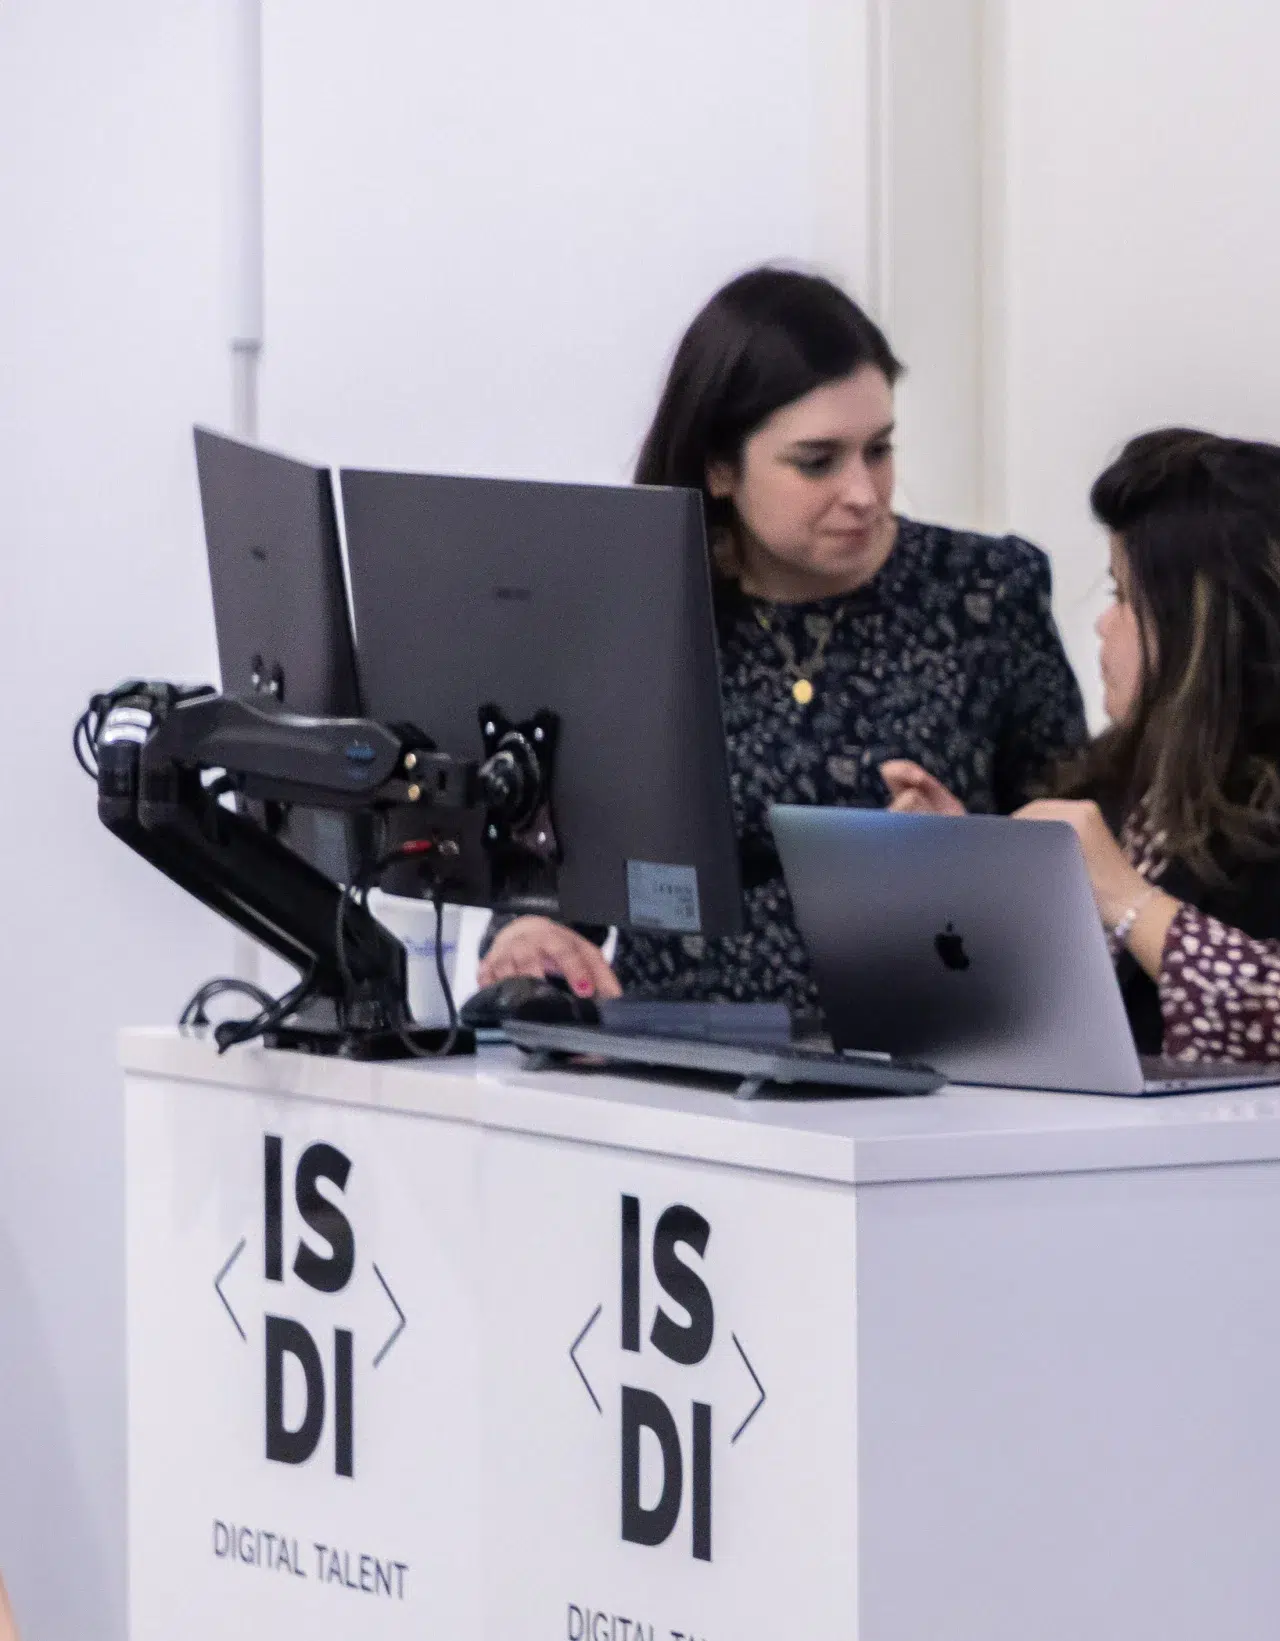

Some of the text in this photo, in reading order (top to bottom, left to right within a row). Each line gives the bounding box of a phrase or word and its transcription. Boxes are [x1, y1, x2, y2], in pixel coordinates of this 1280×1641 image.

[264, 1132, 355, 1294] IS
[620, 1193, 714, 1366] IS
[264, 1311, 355, 1478] DI
[620, 1384, 713, 1563] DI
[213, 1517, 409, 1600] DIGITAL TALENT
